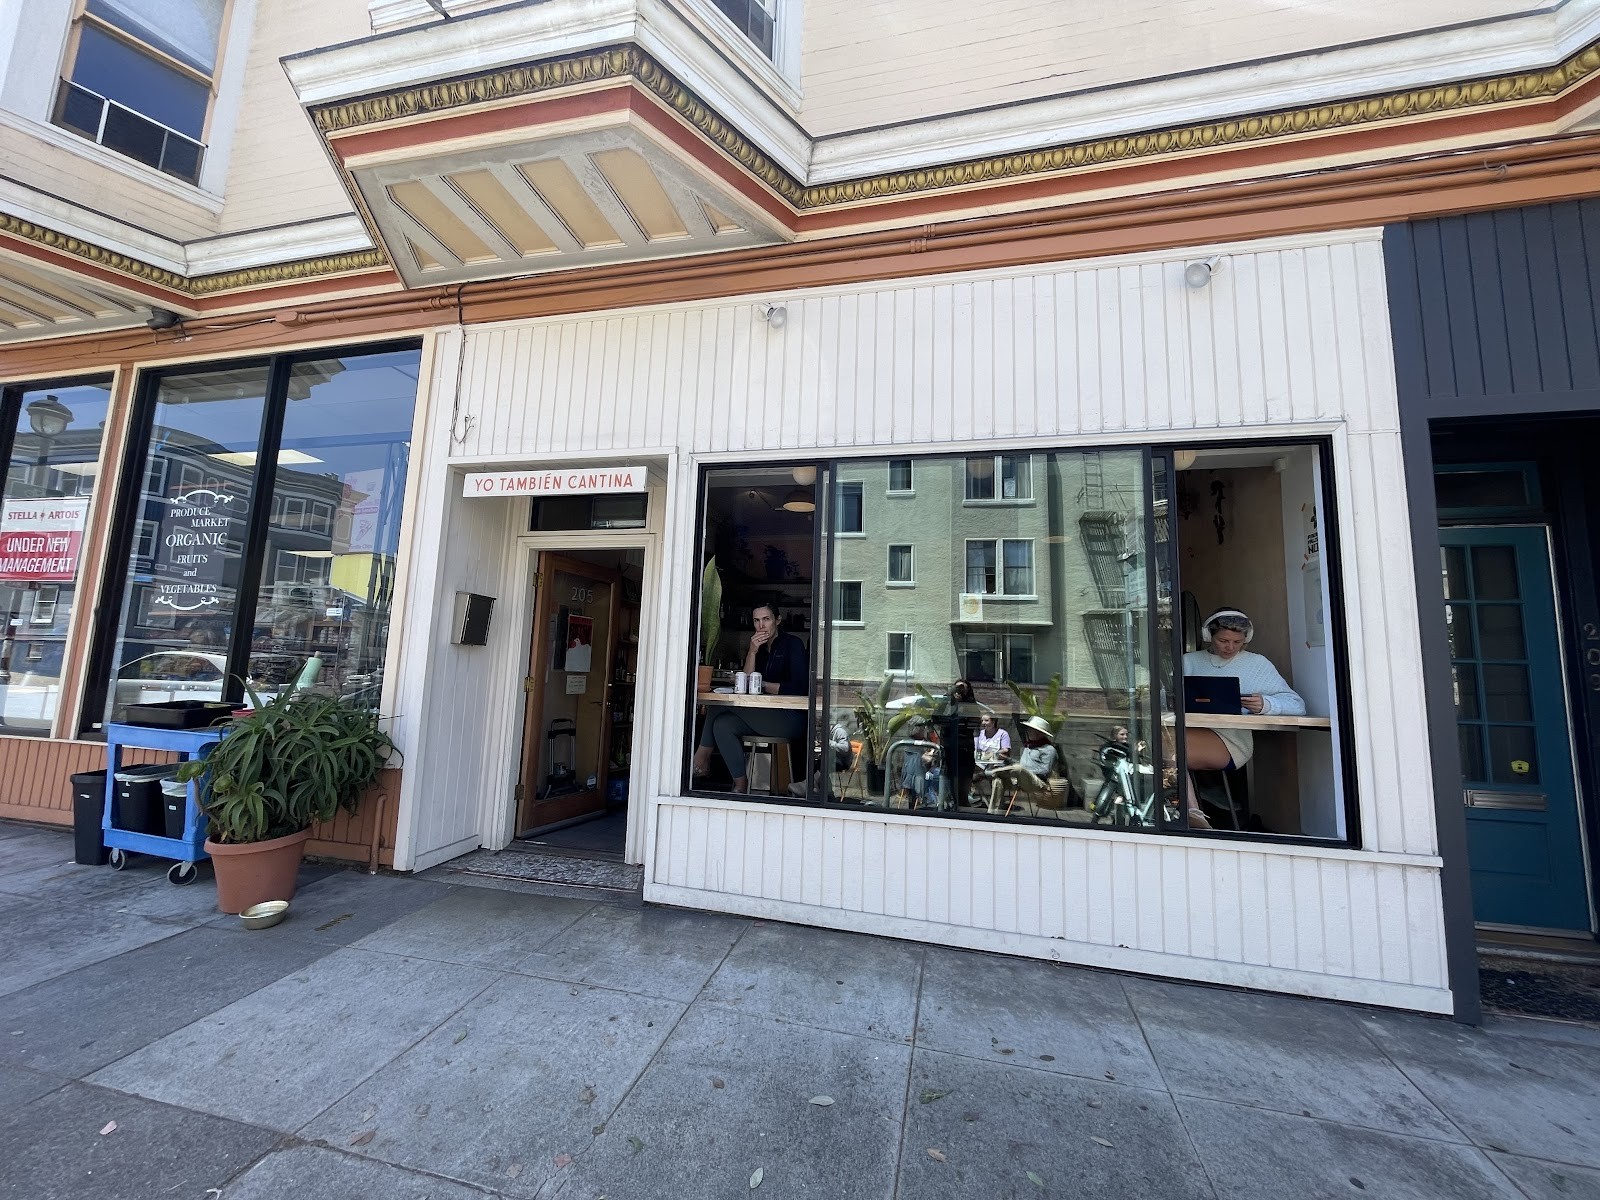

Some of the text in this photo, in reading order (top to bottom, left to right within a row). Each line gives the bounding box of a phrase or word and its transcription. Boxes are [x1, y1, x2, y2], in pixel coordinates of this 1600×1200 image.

[475, 473, 633, 492] YO TAMBIÉN CANTINA
[8, 510, 80, 520] STELLA ARTOIS
[170, 507, 211, 518] PRODUCE
[191, 518, 230, 528] MARKET
[7, 537, 71, 553] UNDER NEW
[165, 532, 228, 547] ORGANIC
[177, 554, 208, 564] FRUITS
[0, 557, 74, 573] MANAGEMENT
[183, 567, 197, 577] and
[161, 583, 217, 594] VEGETABLES
[571, 586, 594, 604] 205
